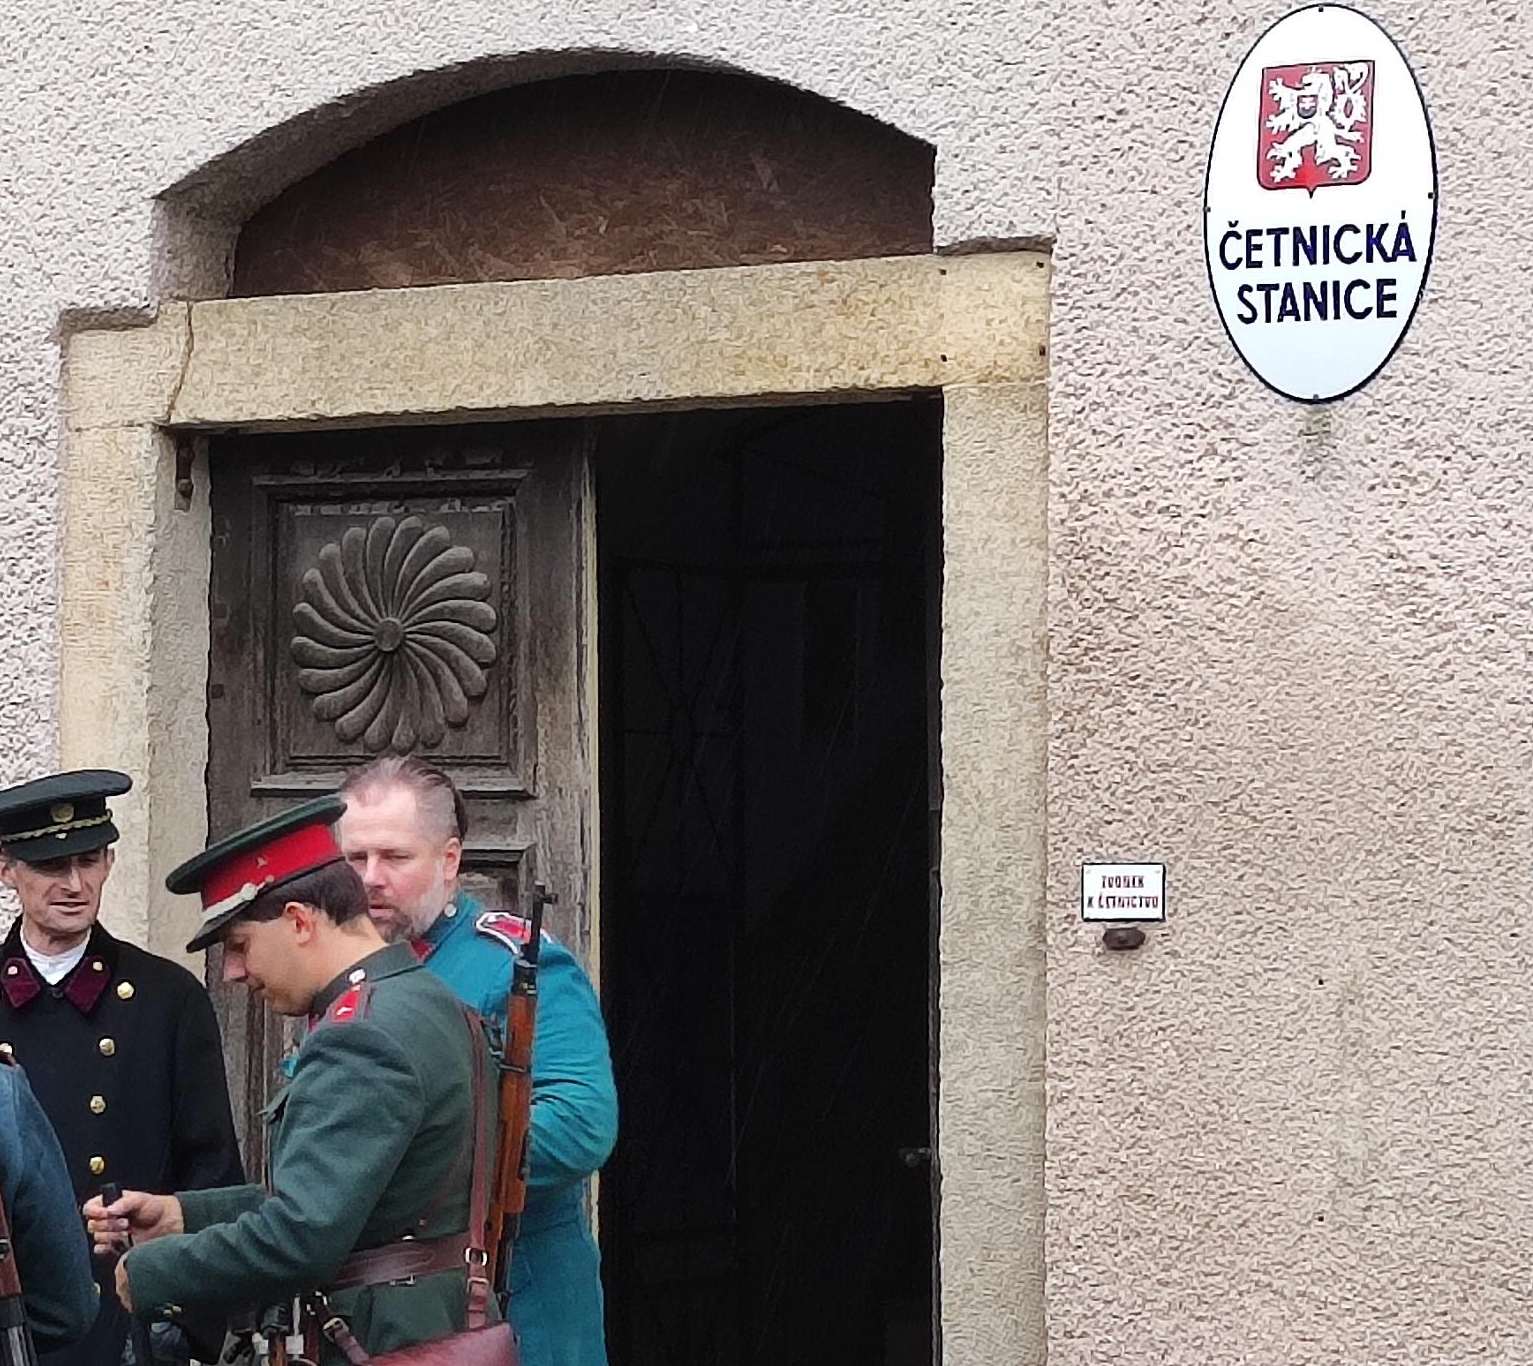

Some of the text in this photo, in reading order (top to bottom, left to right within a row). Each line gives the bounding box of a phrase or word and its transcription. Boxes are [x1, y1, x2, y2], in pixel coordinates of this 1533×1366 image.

[1219, 210, 1417, 271] ČETNICKÁ
[1236, 278, 1398, 325] STANICE
[1086, 896, 1095, 909] K
